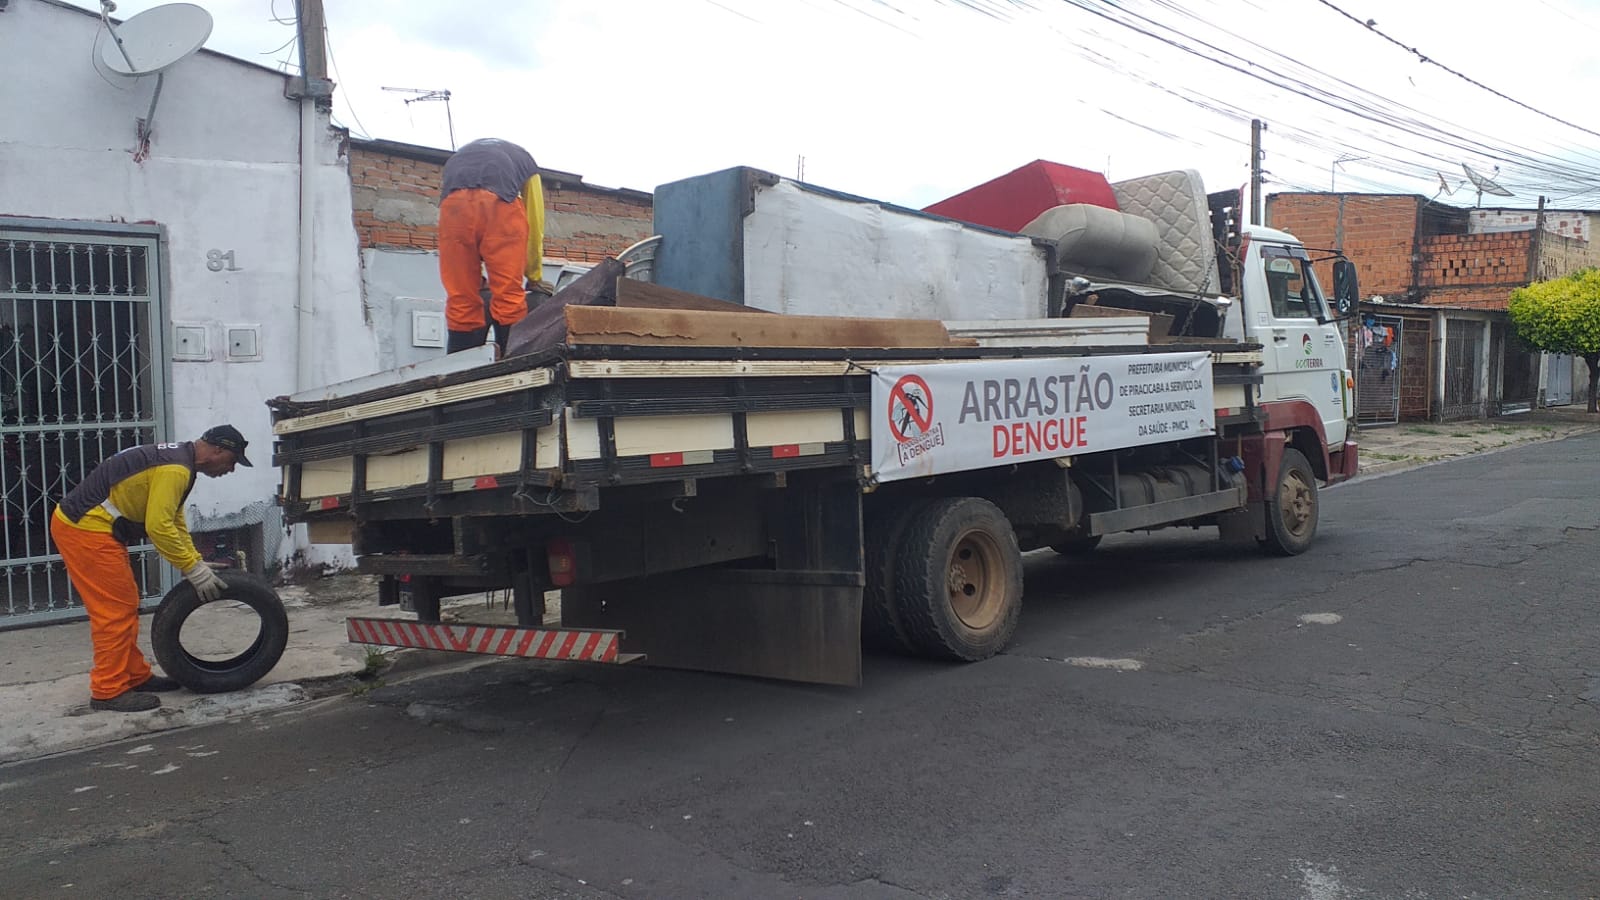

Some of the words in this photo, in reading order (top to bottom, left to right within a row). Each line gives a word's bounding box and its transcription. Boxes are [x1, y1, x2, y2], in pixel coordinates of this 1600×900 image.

[206, 248, 243, 272] 81
[1128, 363, 1163, 375] PREFEITURA
[1163, 361, 1195, 372] MUNICIPAL
[958, 365, 1114, 424] ARRASTÃO
[1119, 385, 1128, 397] DE
[1129, 383, 1164, 396] PIRACICABA
[1165, 383, 1170, 392] A
[1170, 380, 1193, 392] SERVIÇO
[1194, 379, 1202, 390] DA
[1128, 404, 1164, 417] SECRETARIA
[1165, 400, 1196, 412] MUNICIPAL
[992, 416, 1088, 459] DENGUE
[1138, 425, 1148, 436] DA
[1149, 420, 1168, 435] SAÚDE
[903, 452, 909, 462] A
[909, 435, 941, 458] DENGUE
